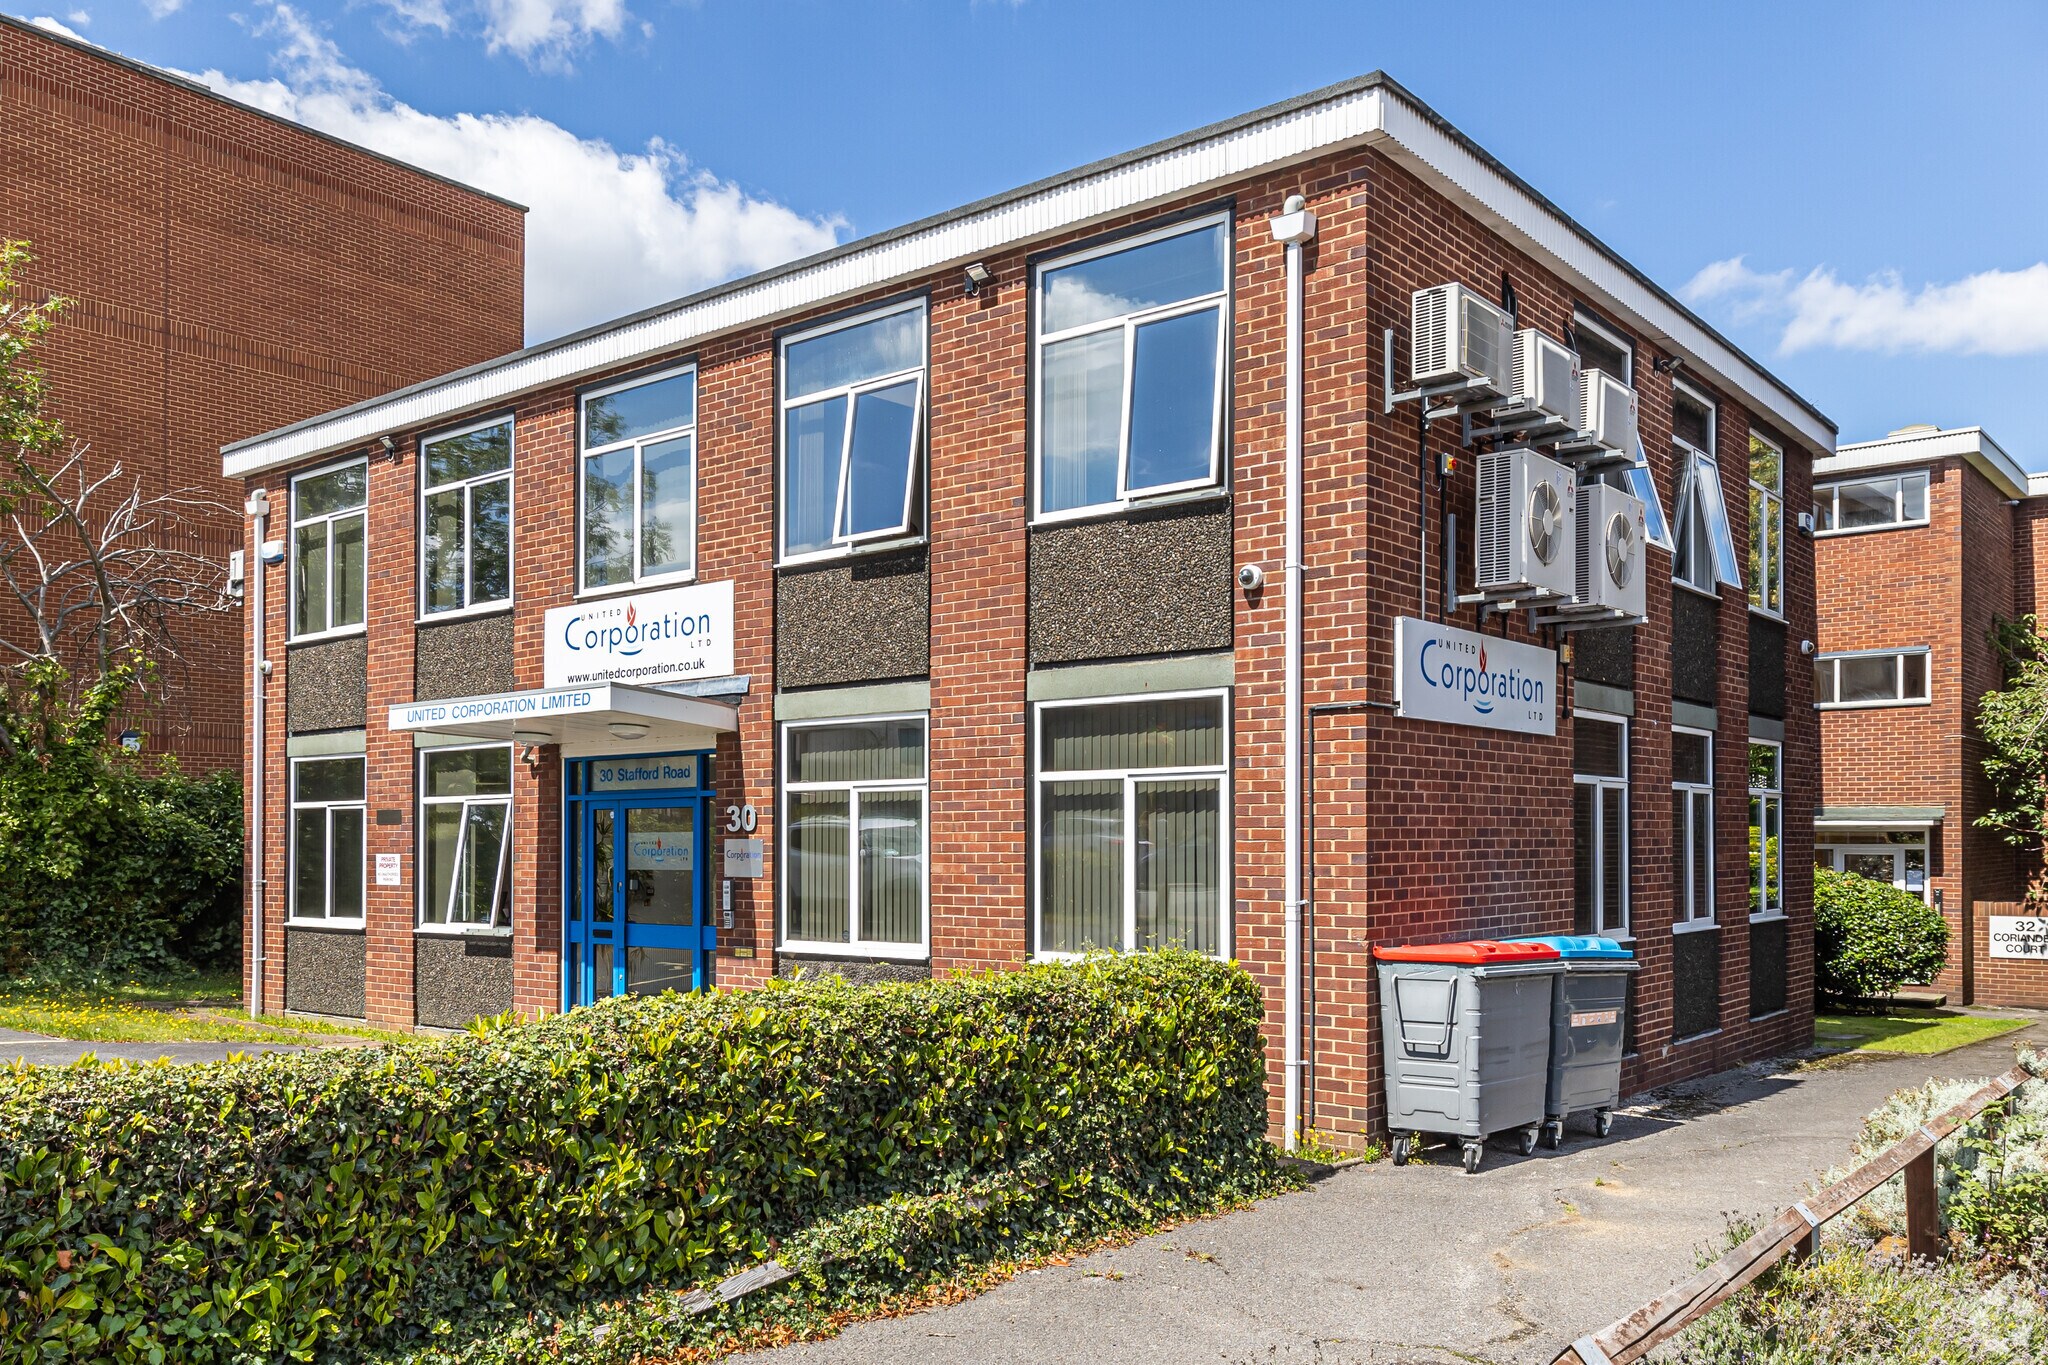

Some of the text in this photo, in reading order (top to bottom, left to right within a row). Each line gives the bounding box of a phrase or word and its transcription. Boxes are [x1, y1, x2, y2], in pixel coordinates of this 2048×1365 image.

[581, 608, 622, 622] UNITED
[565, 612, 711, 653] Corporation
[690, 638, 712, 649] LTD
[1438, 638, 1476, 655] UNITED
[567, 658, 706, 684] www.unitedcorporation.co.uk
[1420, 639, 1544, 704] Corporation
[407, 692, 592, 723] UNITED CORPORATION LIMITED
[1528, 710, 1544, 721] LTD
[600, 765, 691, 782] 30 Stafford Road
[726, 804, 757, 832] 30
[634, 842, 689, 858] Corporation
[726, 849, 761, 860] Corporation
[2015, 920, 2036, 932] 32
[2005, 944, 2045, 954] COURT
